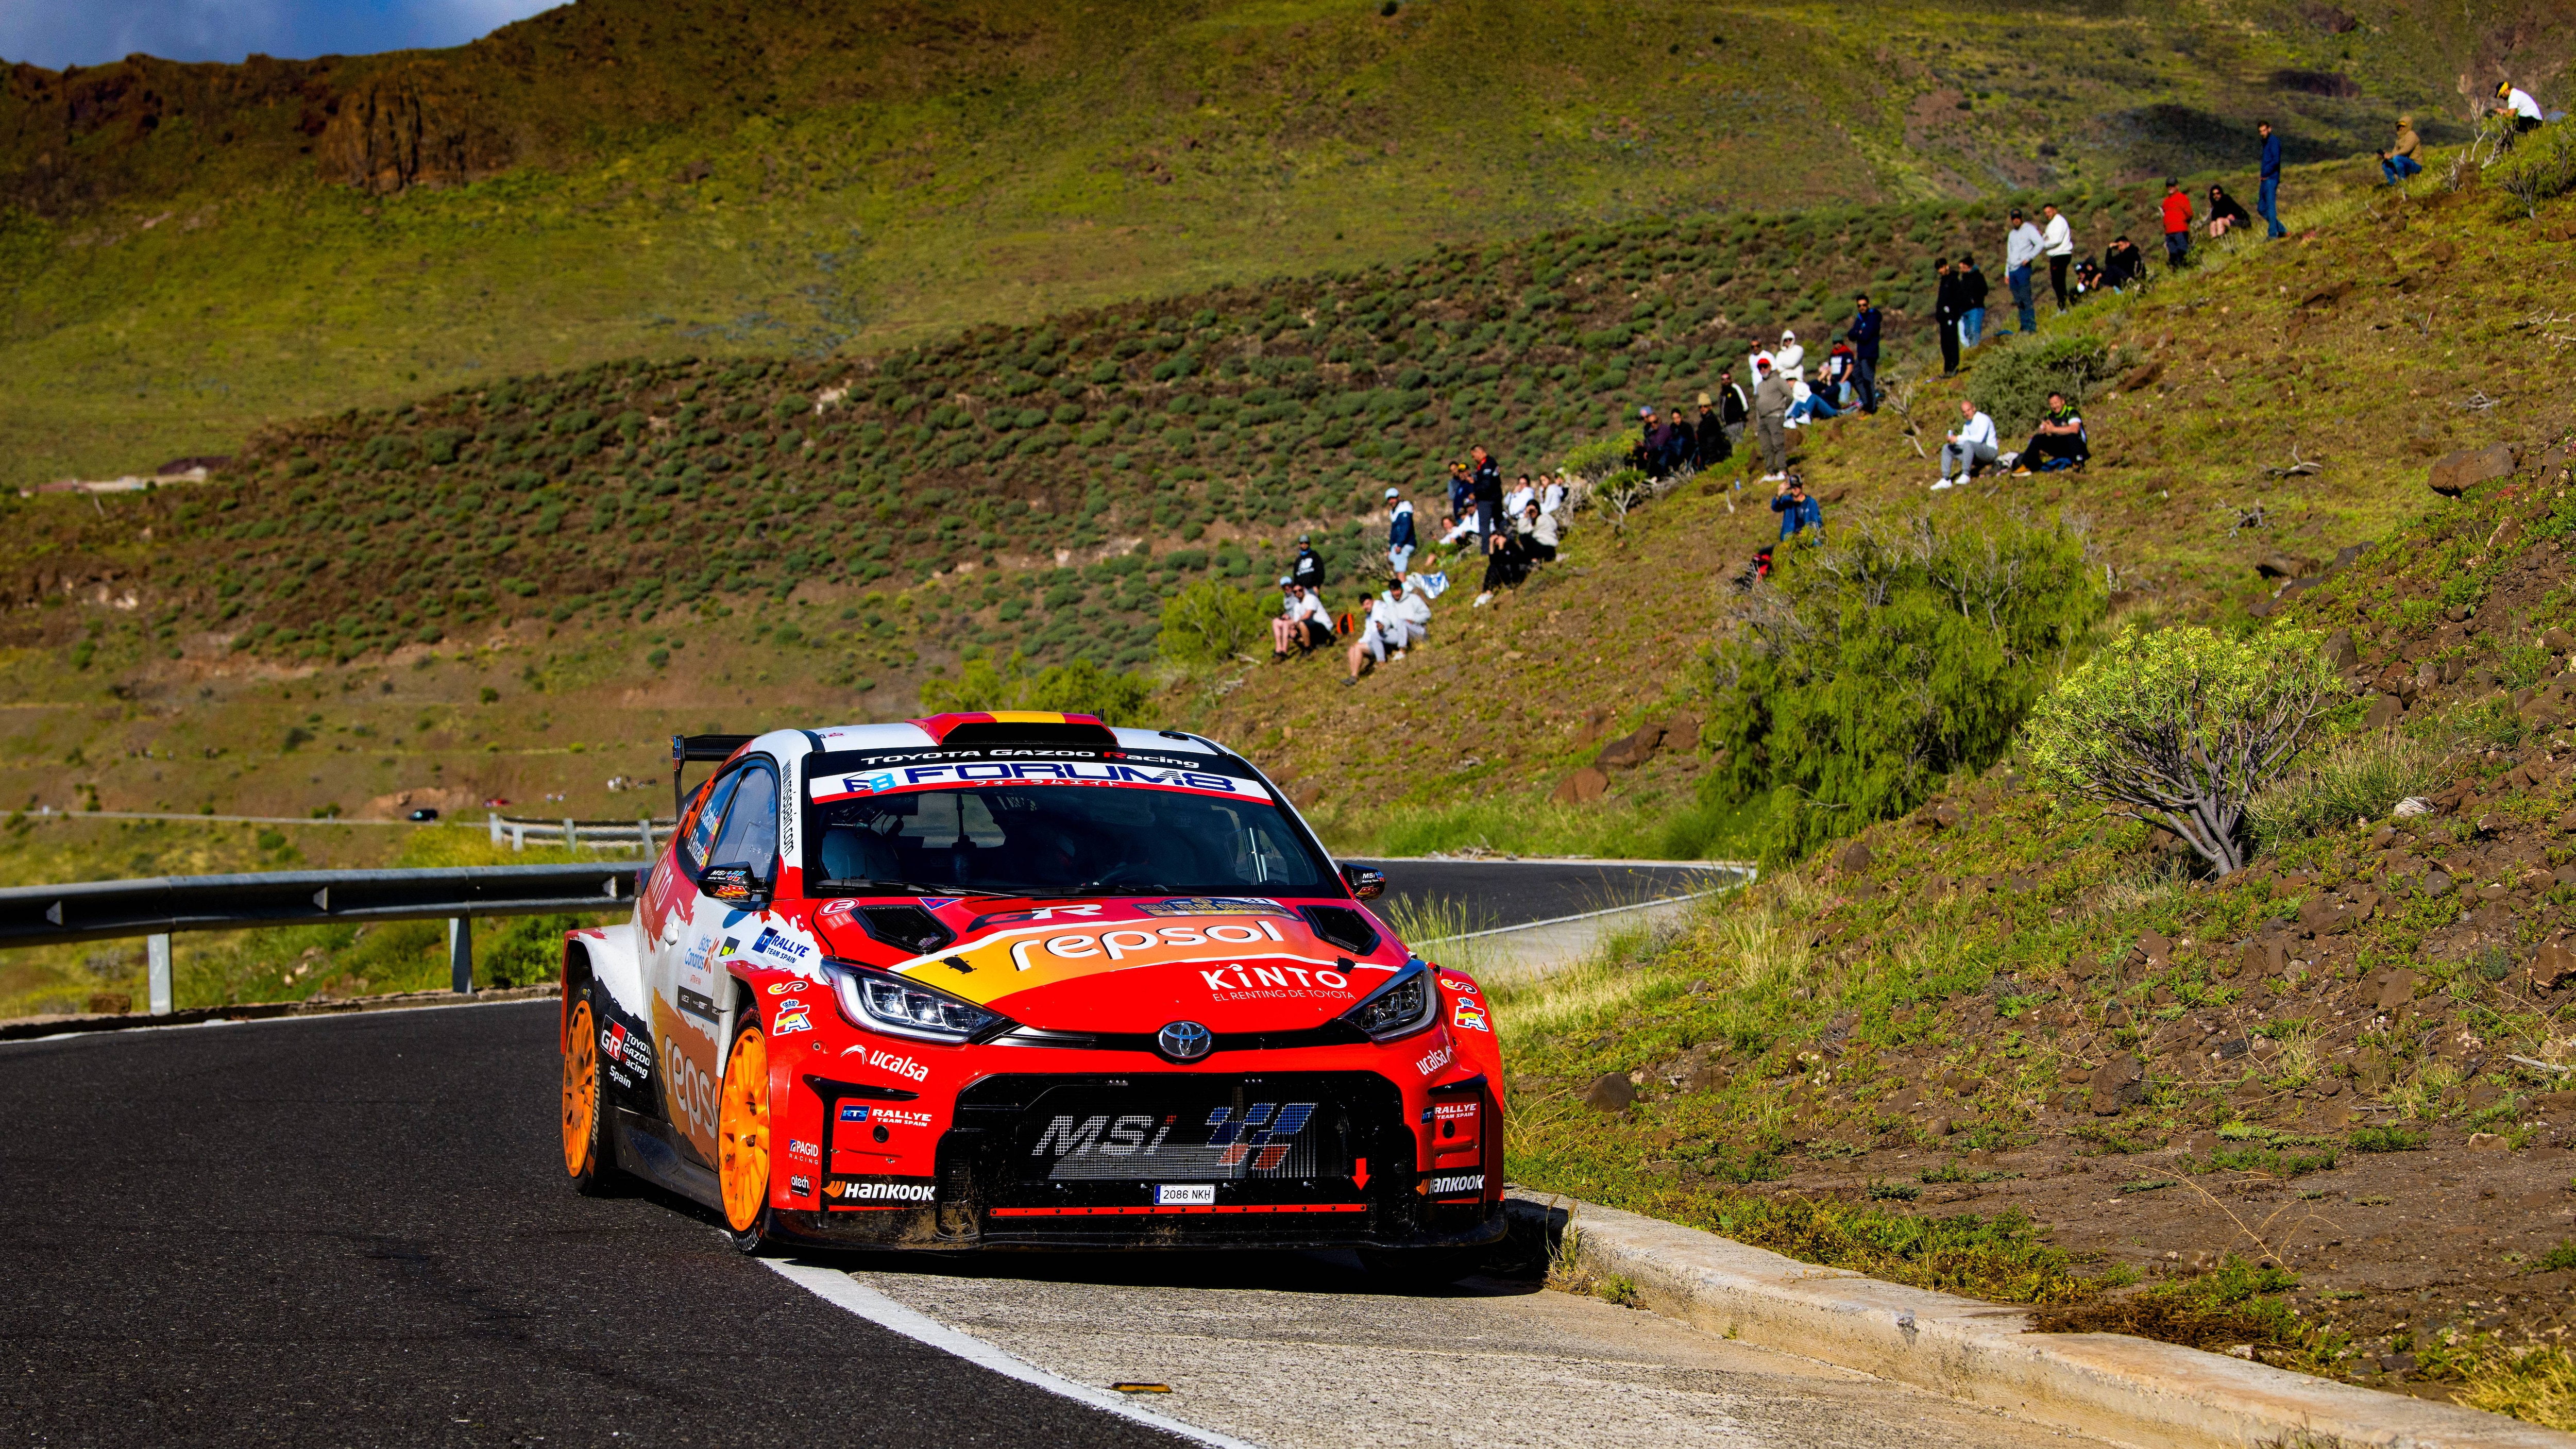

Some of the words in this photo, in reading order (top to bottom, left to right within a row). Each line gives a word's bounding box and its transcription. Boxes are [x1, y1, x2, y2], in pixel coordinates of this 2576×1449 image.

[861, 750, 981, 765] TOYOTA
[1104, 752, 1199, 768] Racing
[904, 763, 1236, 791] FORUM8
[781, 759, 796, 857] www.msispain.com
[698, 933, 711, 952] Islas
[757, 934, 772, 946] RTS
[771, 935, 810, 958] RALLYE
[1010, 921, 1284, 972] repsol
[685, 948, 704, 970] Canarias
[767, 948, 780, 957] TEAM
[780, 953, 797, 964] SPAIN
[1230, 989, 1286, 1000] RENTING
[1307, 990, 1356, 1000] TOYOTA
[601, 1030, 621, 1058] GR
[623, 1043, 650, 1066] GAZOO
[621, 1052, 648, 1079] Racing
[870, 1050, 929, 1082] ucalsa
[1416, 1050, 1448, 1075] ucalsa
[609, 1065, 631, 1088] Spain
[665, 1034, 718, 1139] reps
[872, 1108, 932, 1122] RALLYE
[1435, 1103, 1477, 1114] RALLYE
[789, 1153, 818, 1165] RACING
[796, 1140, 819, 1157] PAGID
[791, 1175, 809, 1189] atech
[1163, 1190, 1188, 1199] 2086
[1192, 1190, 1210, 1199] NKH
